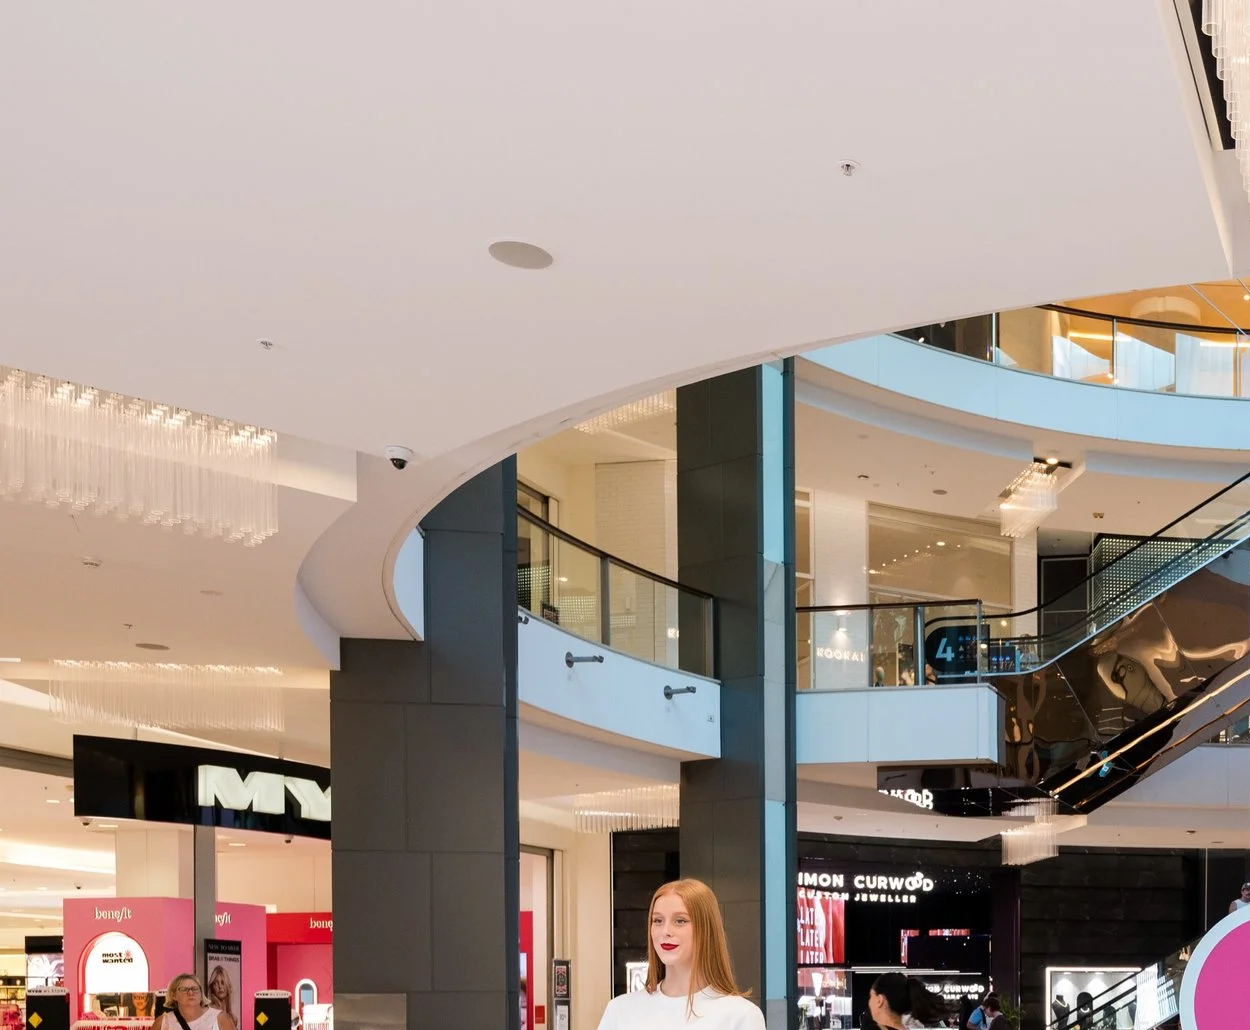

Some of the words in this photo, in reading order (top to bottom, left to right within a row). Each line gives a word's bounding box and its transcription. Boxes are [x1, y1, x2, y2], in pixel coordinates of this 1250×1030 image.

[935, 637, 955, 662] 4
[853, 871, 934, 892] CURWOOD
[798, 889, 849, 901] CUSTOM
[854, 893, 917, 903] JEWELLER
[95, 906, 132, 923] benefit
